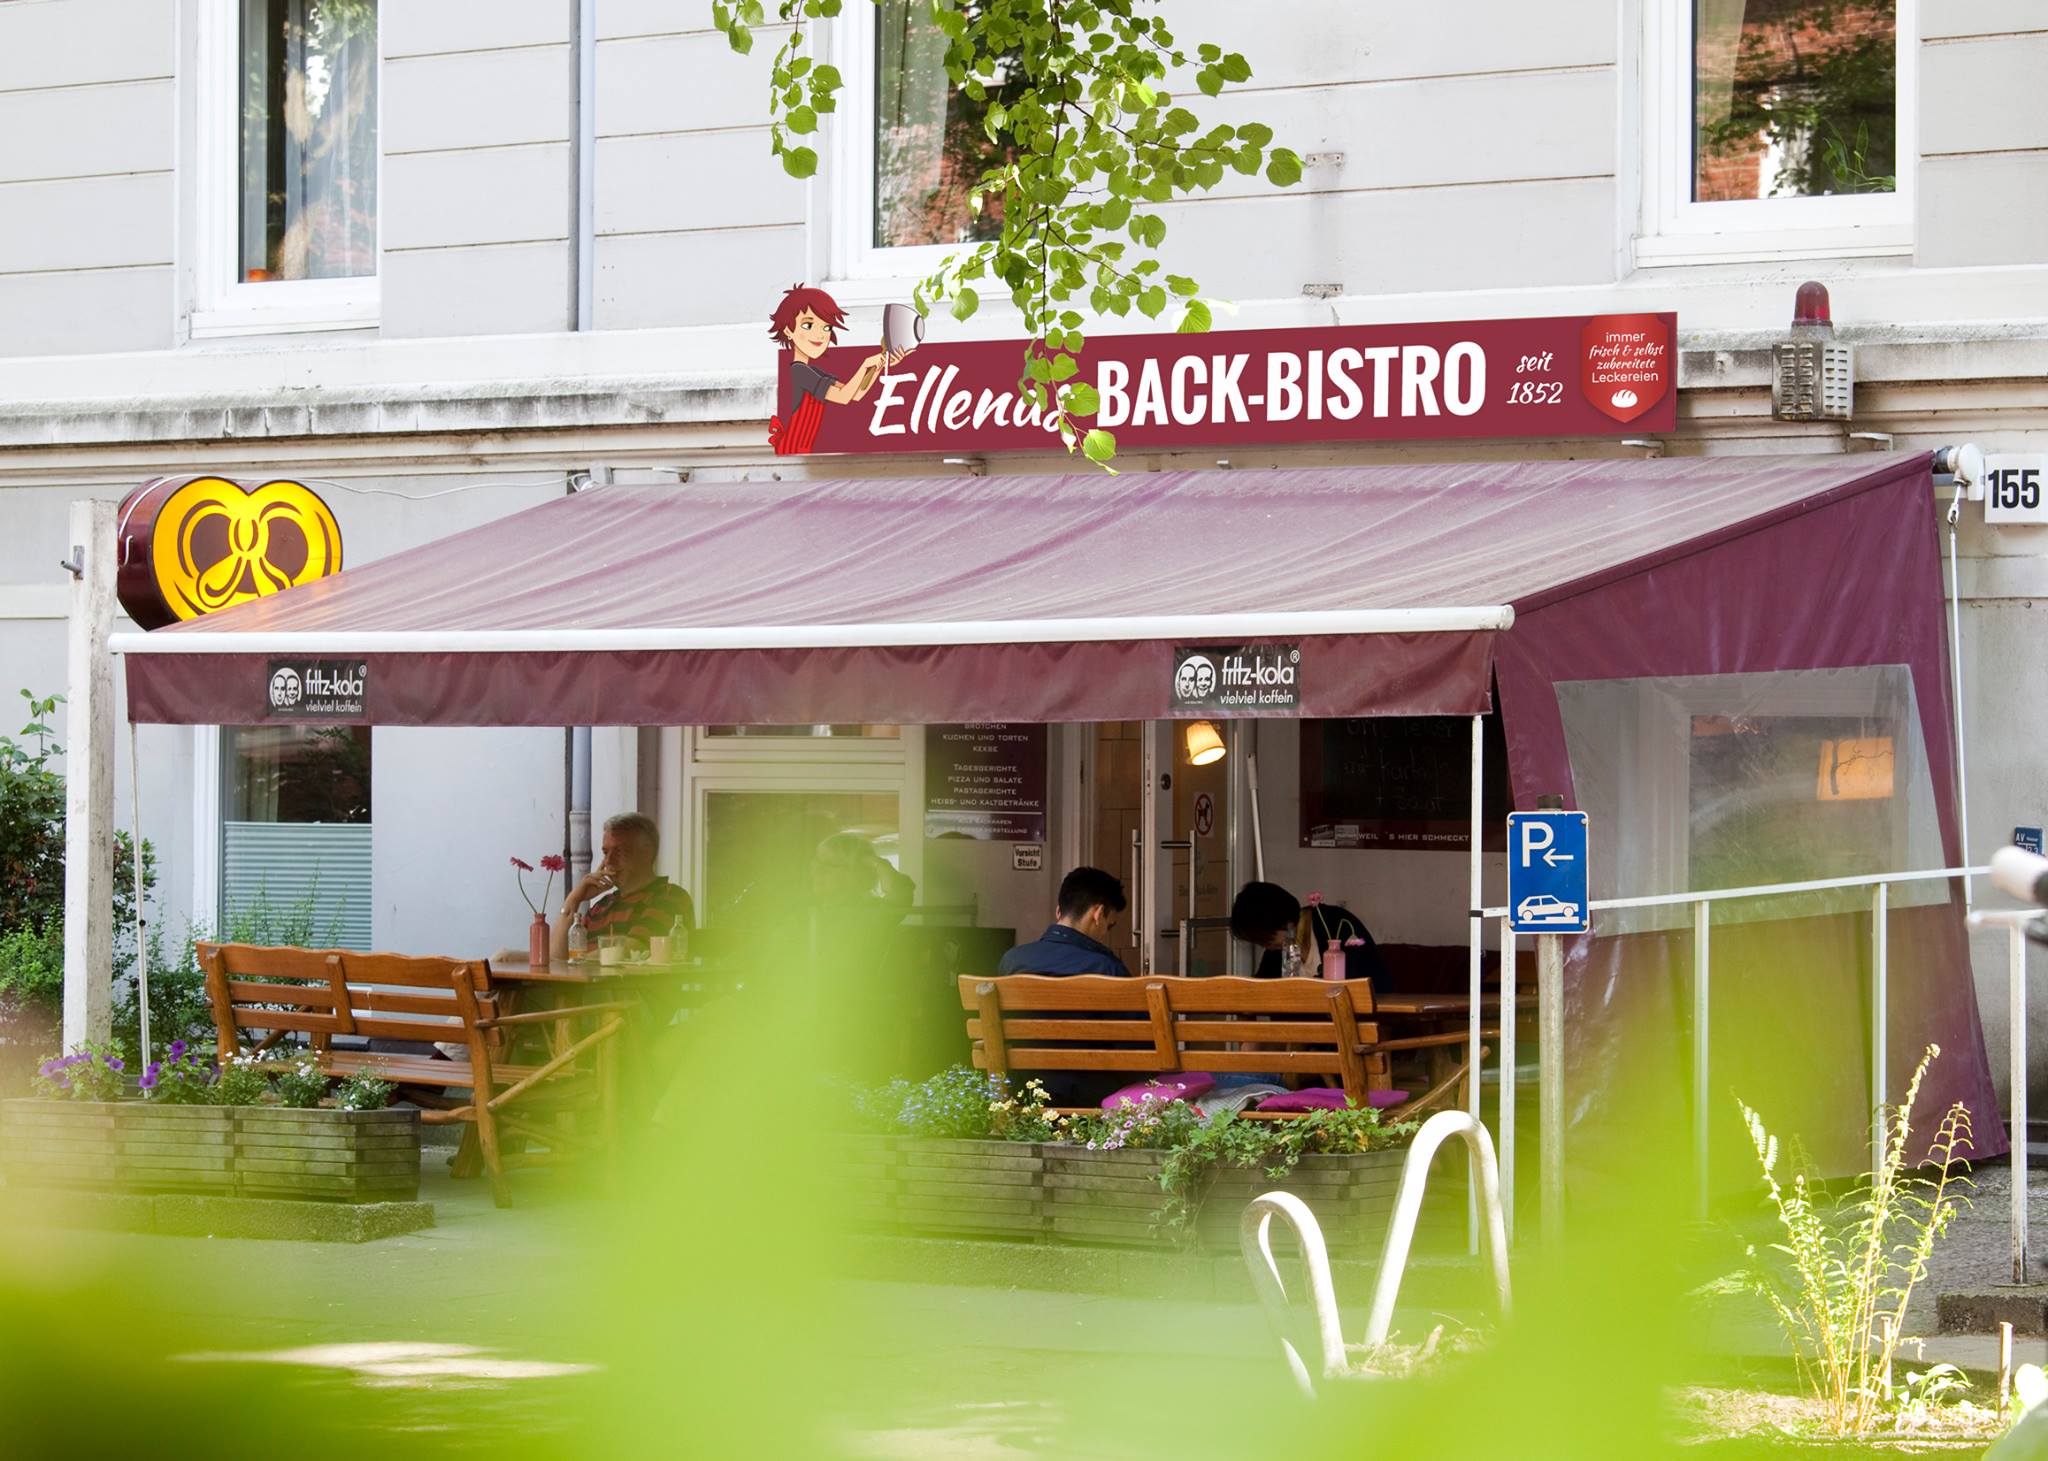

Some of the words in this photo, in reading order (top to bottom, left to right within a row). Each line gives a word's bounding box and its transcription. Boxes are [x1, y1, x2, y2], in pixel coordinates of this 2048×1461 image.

[1605, 332, 1646, 343] immer
[1589, 344, 1620, 360] frisch
[1622, 344, 1632, 357] &
[1633, 342, 1665, 357] selbst
[1516, 351, 1554, 374] seit
[1596, 358, 1656, 371] zubereitete
[1097, 340, 1487, 428] BACK-BISTRO
[1592, 371, 1659, 384] Leckereien
[1506, 381, 1564, 405] 1852
[1988, 469, 2040, 509] 155
[1220, 690, 1257, 705] vielviel
[1258, 689, 1294, 705] koffein
[306, 699, 334, 713] vielviel
[335, 699, 362, 713] koffein
[1398, 833, 1419, 841] HIER
[1422, 834, 1470, 842] SCHMECKT
[1521, 821, 1555, 868] P
[1015, 847, 1041, 857] Vorsicht
[1017, 857, 1038, 867] Stufe
